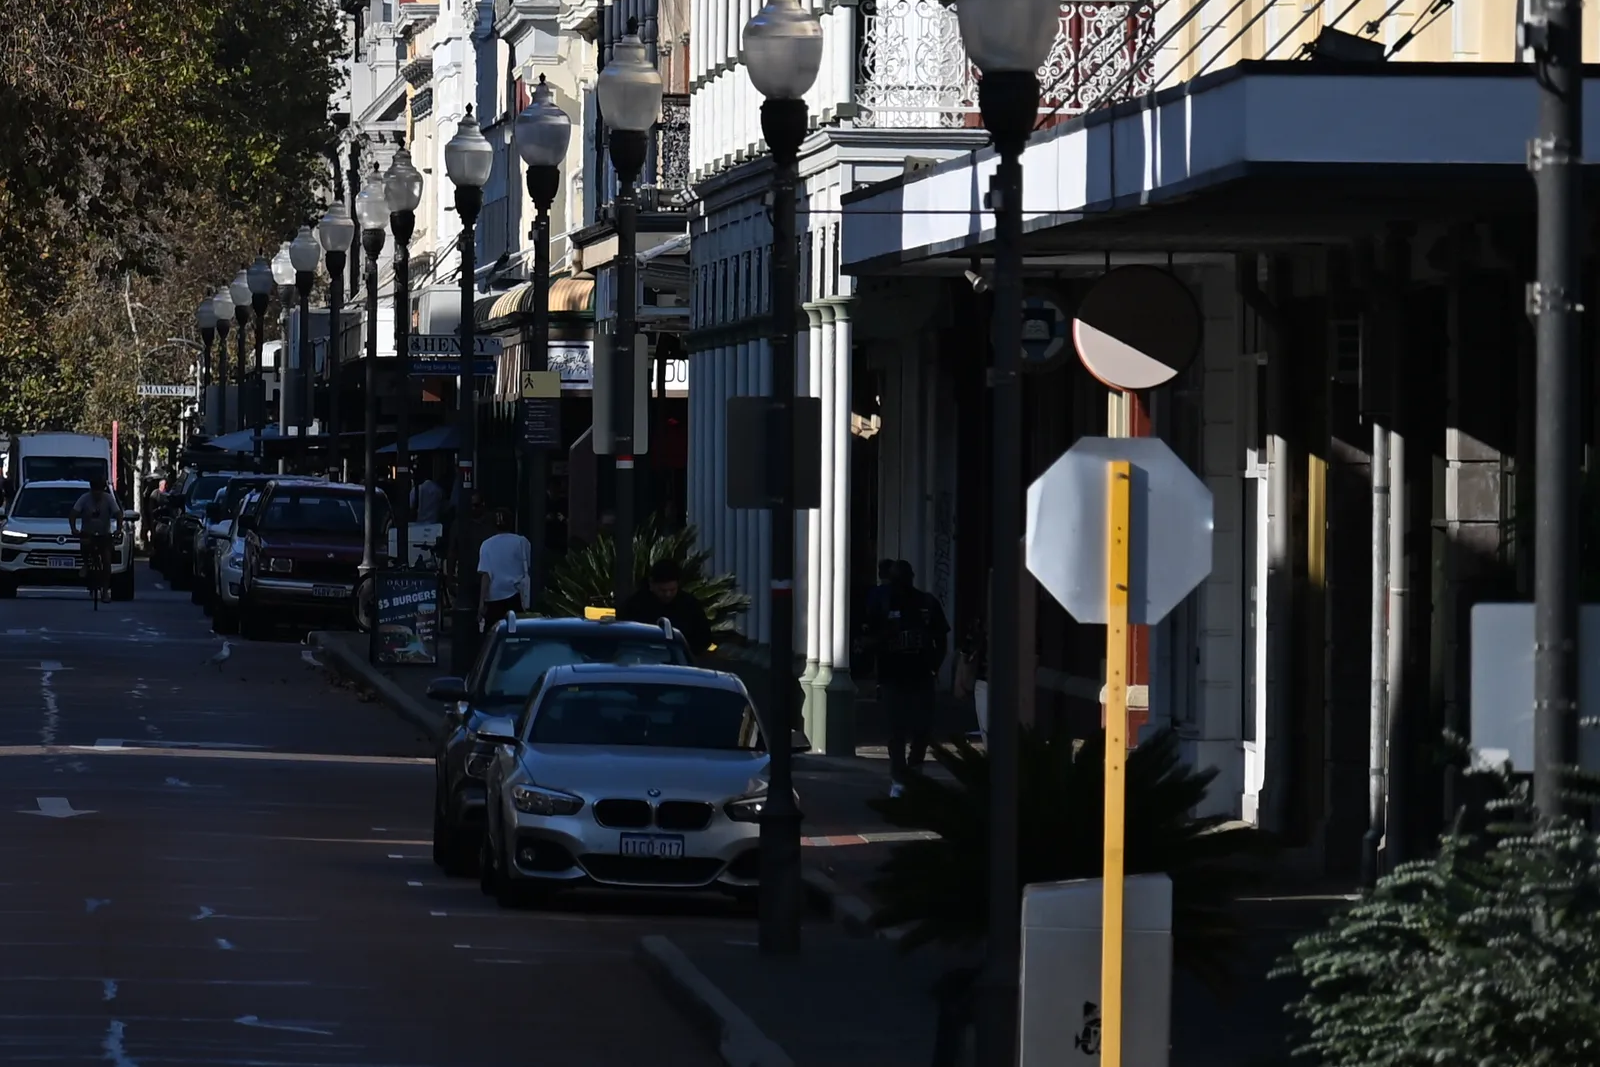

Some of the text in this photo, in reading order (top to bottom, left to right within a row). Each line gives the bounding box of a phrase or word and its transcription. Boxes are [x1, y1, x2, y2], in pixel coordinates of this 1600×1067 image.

[423, 337, 488, 352] HENY
[145, 386, 186, 394] MARKET
[378, 590, 437, 610] $5 BURGERS
